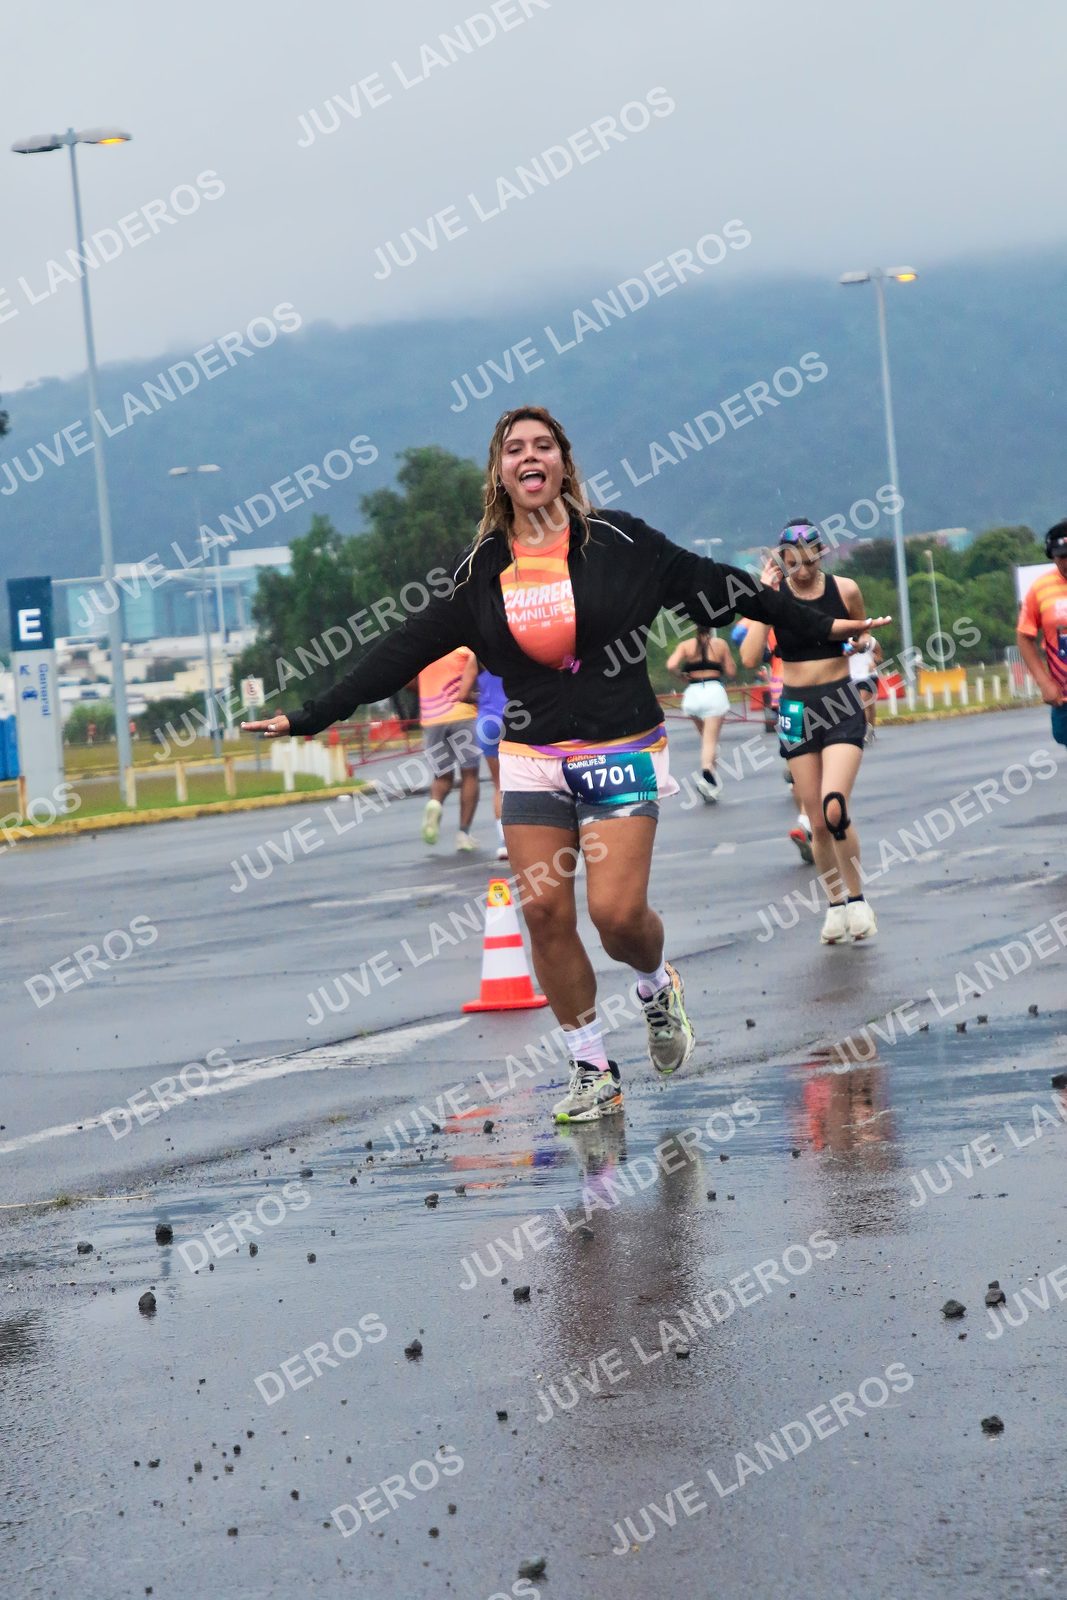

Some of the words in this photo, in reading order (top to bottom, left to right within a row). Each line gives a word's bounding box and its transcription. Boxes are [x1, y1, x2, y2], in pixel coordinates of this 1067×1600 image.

[18, 608, 43, 641] E
[778, 715, 791, 729] 15
[567, 758, 598, 770] OMNILIFE
[581, 764, 636, 789] 1701
